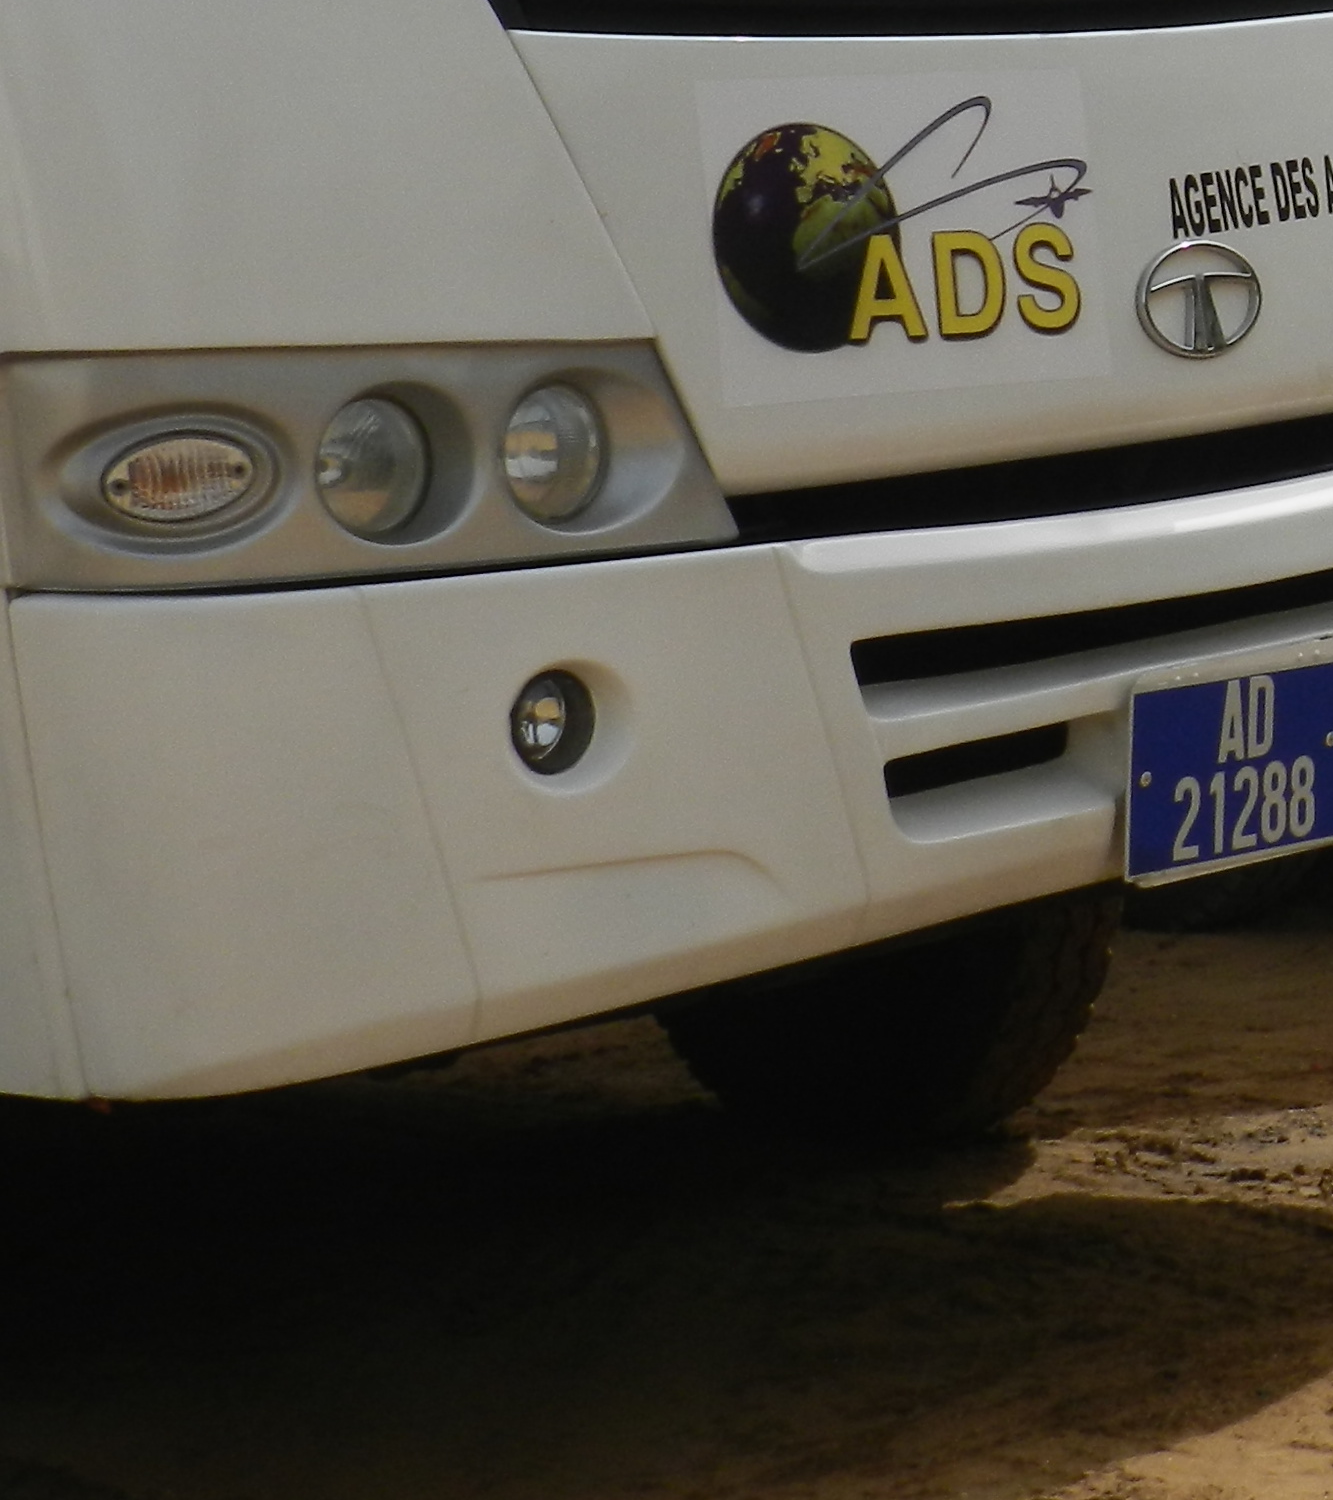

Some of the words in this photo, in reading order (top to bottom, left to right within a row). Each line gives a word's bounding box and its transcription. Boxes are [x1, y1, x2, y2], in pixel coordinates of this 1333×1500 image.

[1168, 164, 1271, 240] AGENCE
[1269, 154, 1320, 223] DES
[848, 221, 1082, 343] ADS
[1216, 674, 1276, 764] AD
[1171, 754, 1316, 862] 21288
